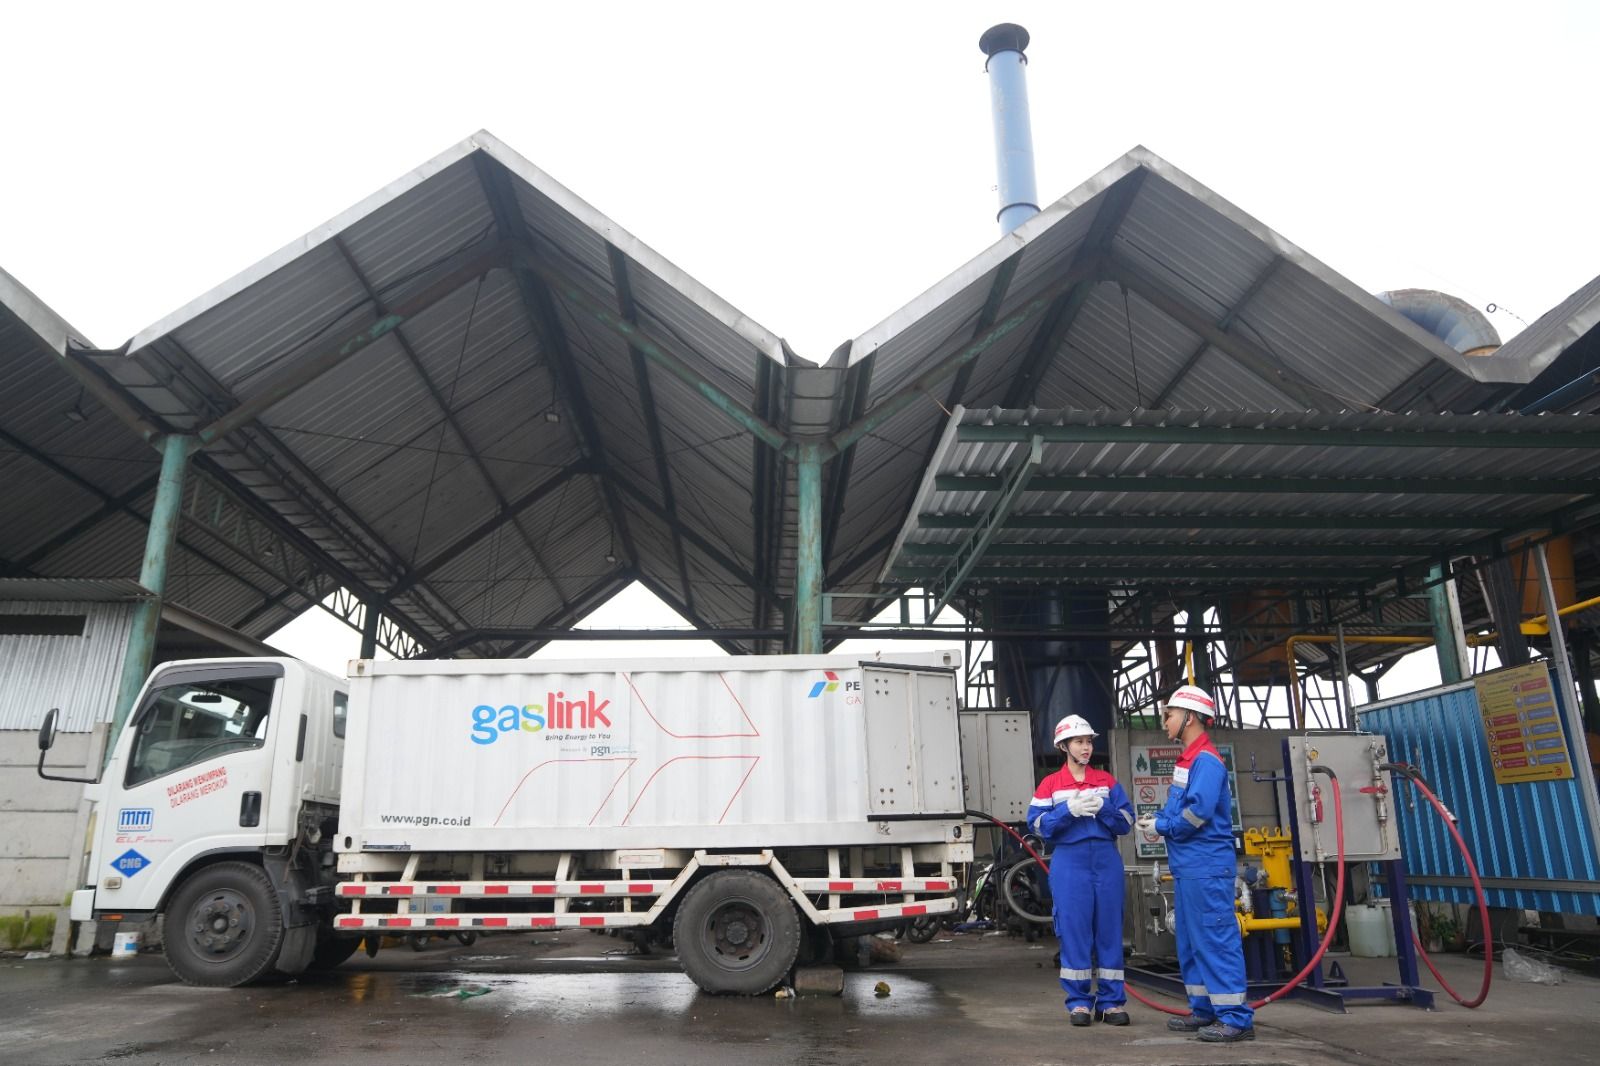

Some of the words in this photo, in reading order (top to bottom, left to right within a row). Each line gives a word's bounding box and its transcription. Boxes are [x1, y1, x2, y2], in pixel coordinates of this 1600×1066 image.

[845, 681, 861, 691] PE
[470, 690, 612, 745] gaslink
[591, 745, 611, 756] pgn
[167, 779, 194, 797] DILARANG
[194, 766, 227, 786] MENUMPANG
[170, 788, 200, 808] DILARANG
[200, 777, 228, 795] MEROKOK
[381, 815, 471, 826] www.pgn.co.id
[115, 835, 146, 843] ELF
[120, 857, 142, 869] CNG
